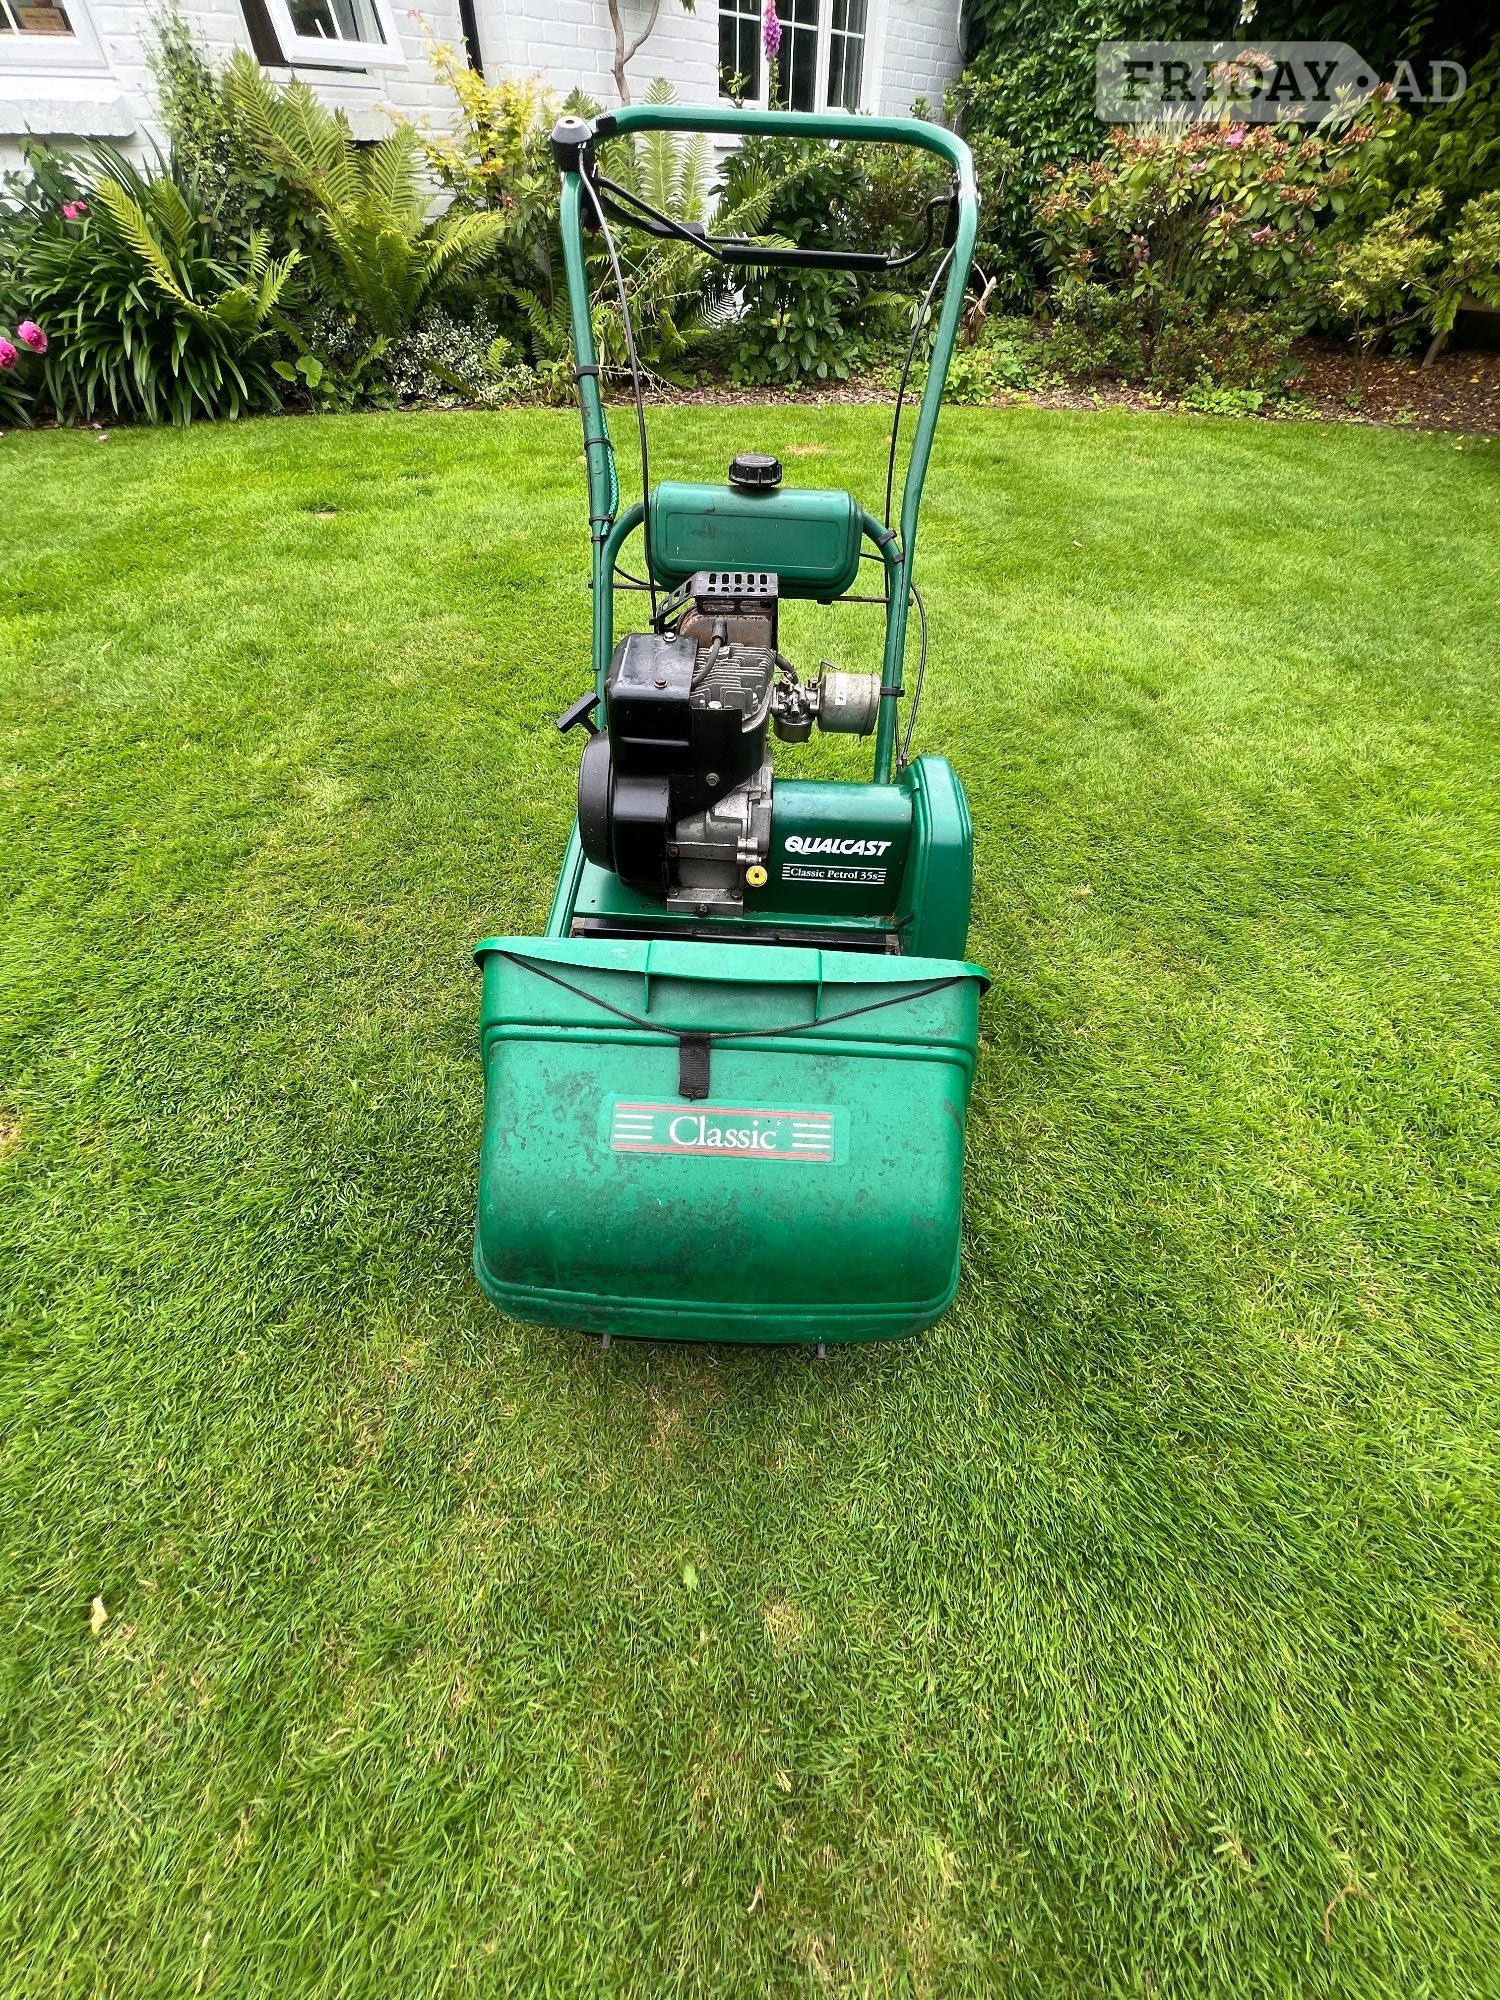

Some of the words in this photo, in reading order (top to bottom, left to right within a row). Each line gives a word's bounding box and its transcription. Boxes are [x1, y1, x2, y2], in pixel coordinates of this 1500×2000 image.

[784, 835, 892, 856] QUALCAST
[790, 868, 825, 878] Classic
[827, 870, 858, 879] Petrol
[860, 872, 878, 880] 35s
[669, 1115, 777, 1150] Classic
